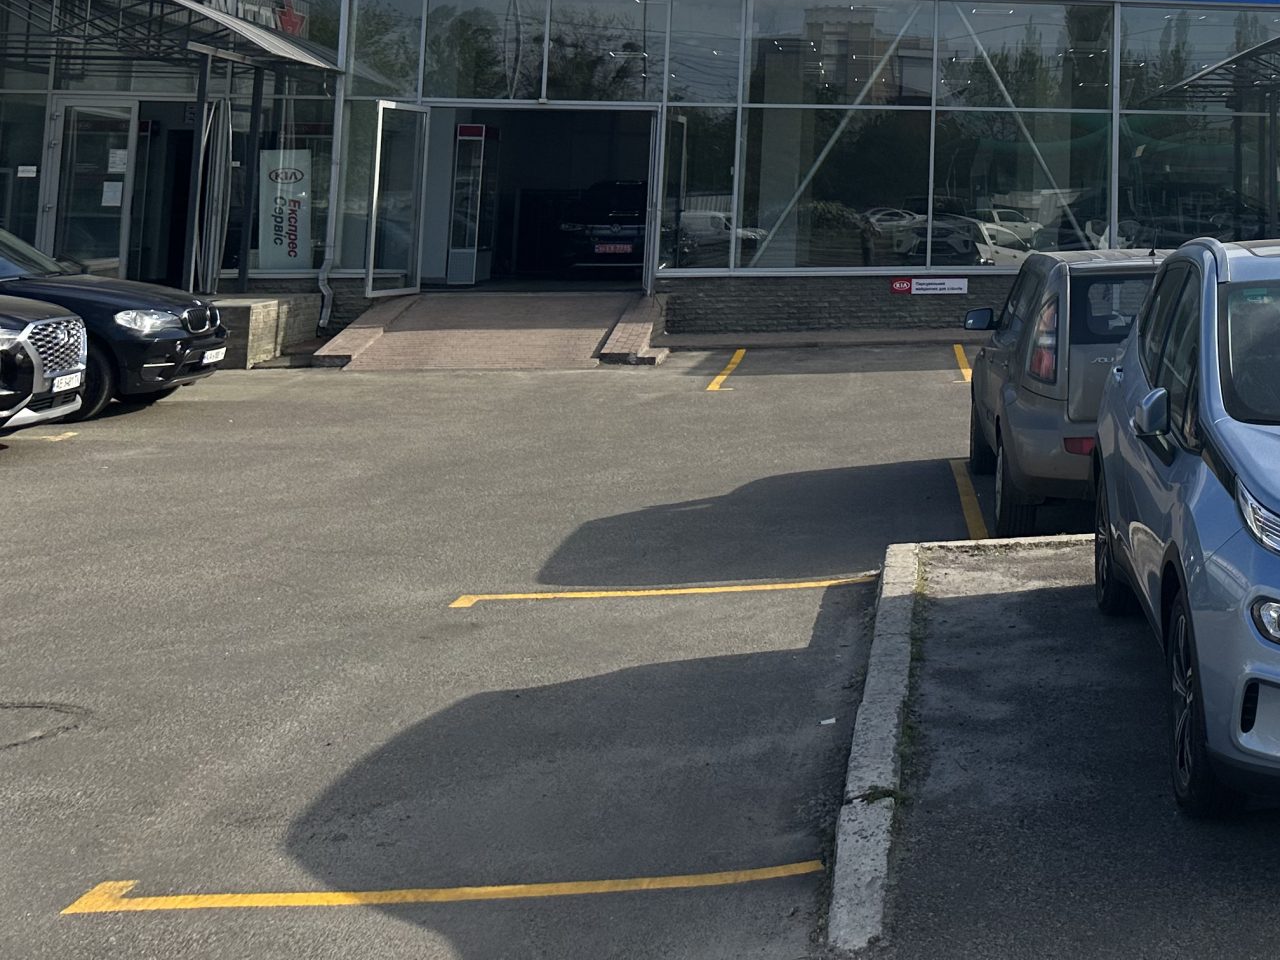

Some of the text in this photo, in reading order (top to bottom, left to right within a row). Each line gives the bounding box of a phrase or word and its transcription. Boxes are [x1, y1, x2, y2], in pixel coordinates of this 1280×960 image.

[273, 170, 299, 181] KIA
[271, 196, 287, 246] Сервіс
[287, 199, 301, 258] Експрес
